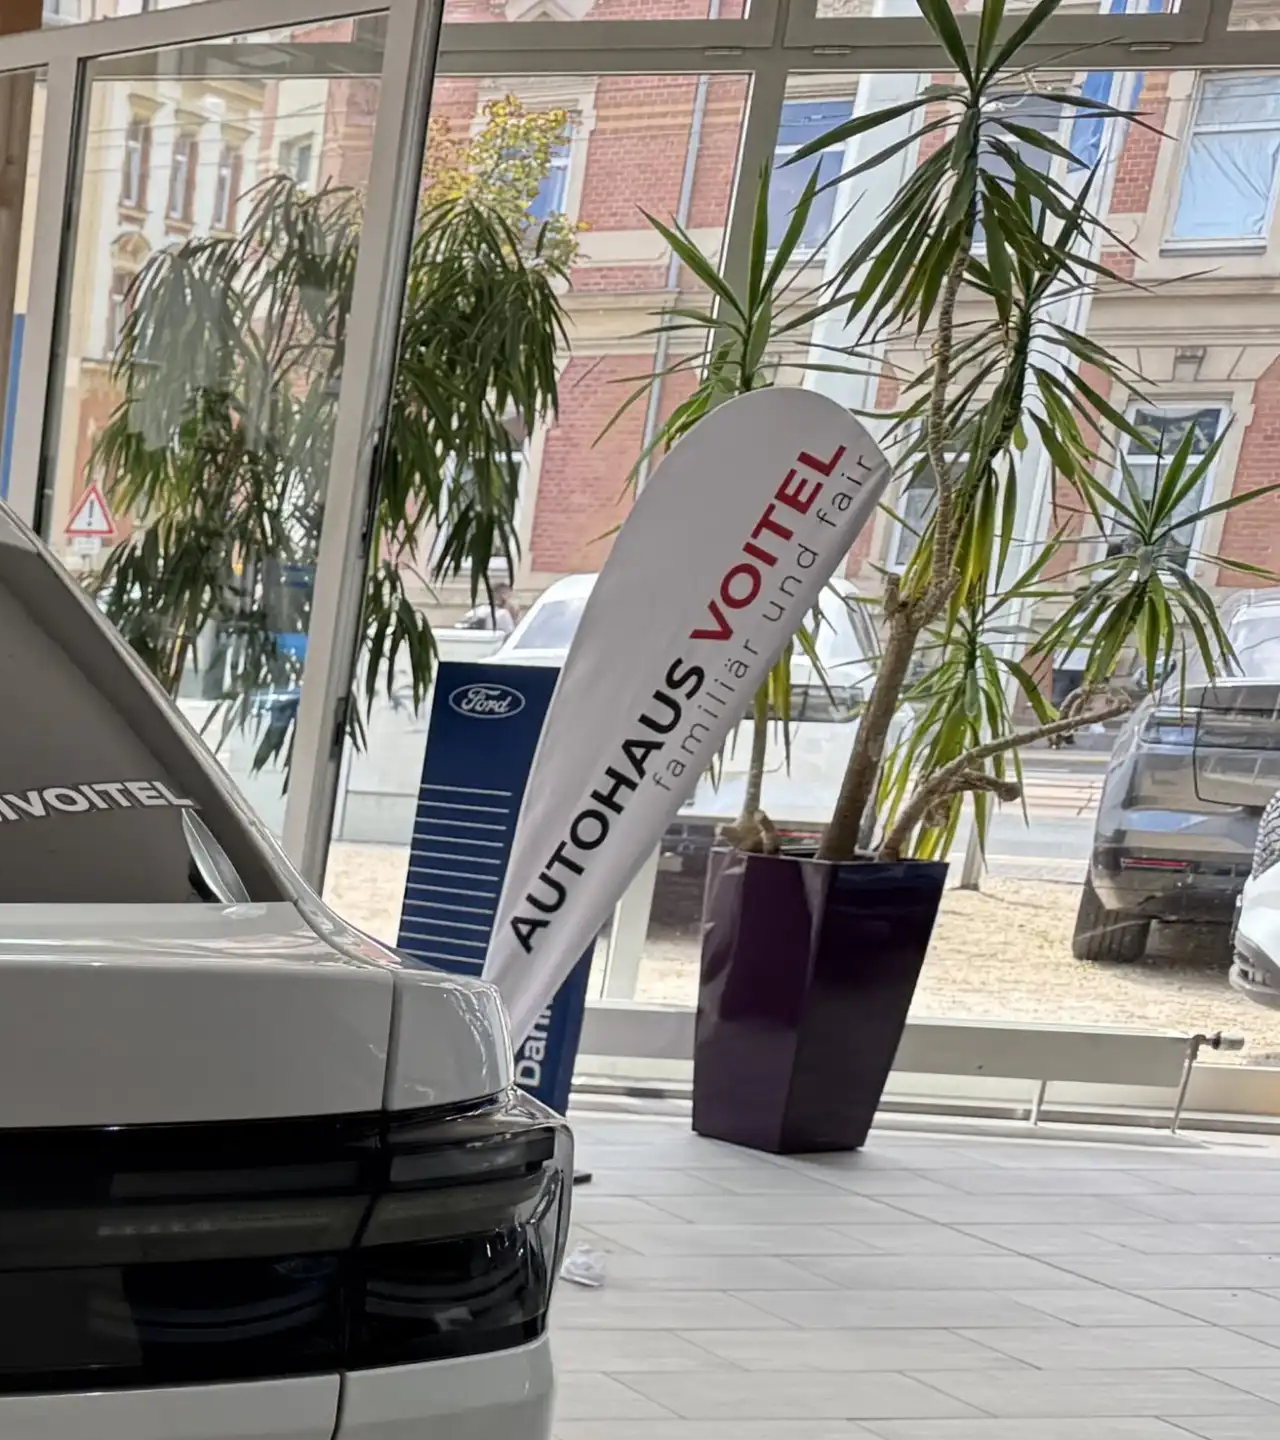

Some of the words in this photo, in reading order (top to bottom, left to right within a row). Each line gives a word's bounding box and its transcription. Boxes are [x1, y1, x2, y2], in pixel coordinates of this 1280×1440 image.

[461, 687, 513, 713] Ford
[510, 657, 705, 954] AUTOHAUS
[689, 445, 847, 641] VOITEL
[652, 639, 759, 791] familiär
[762, 543, 819, 622] und
[816, 455, 873, 527] fair
